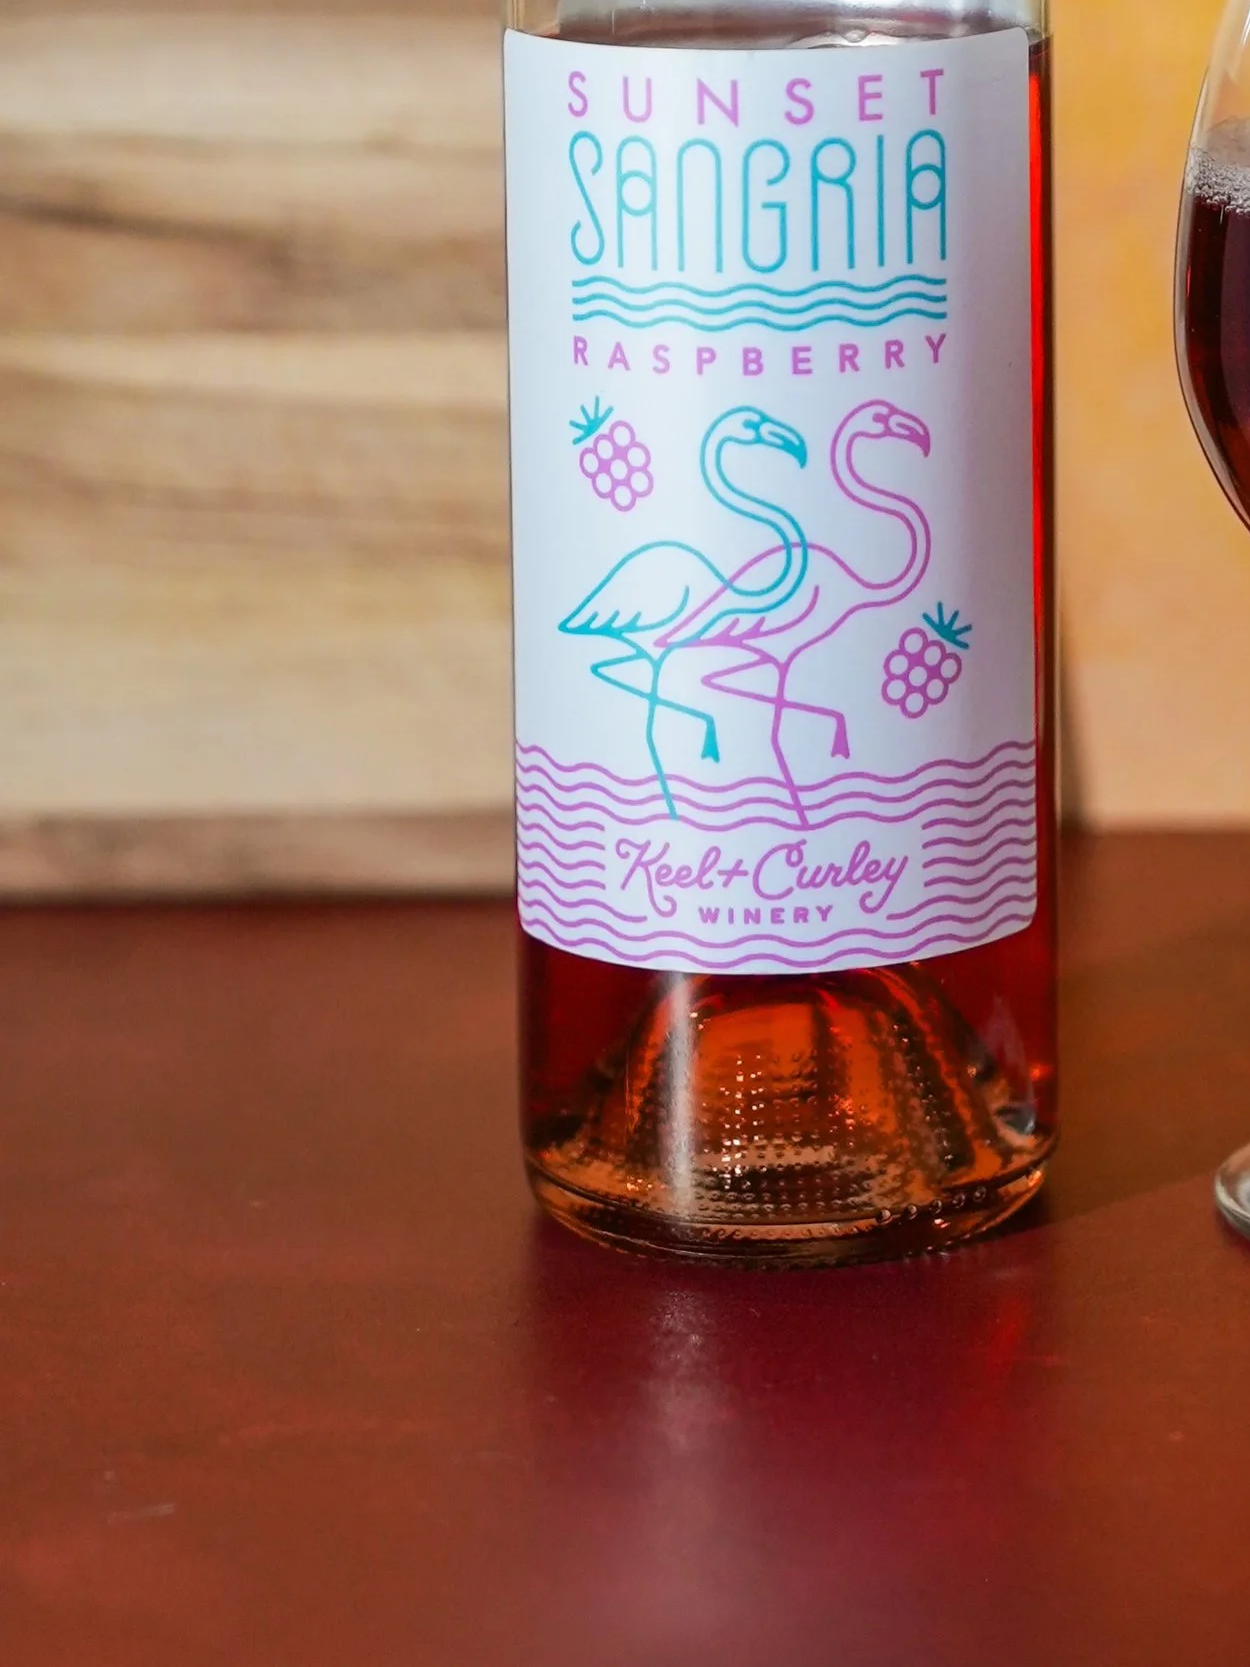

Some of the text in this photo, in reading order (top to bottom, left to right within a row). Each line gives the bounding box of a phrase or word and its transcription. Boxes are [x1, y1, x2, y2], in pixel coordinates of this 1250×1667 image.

[567, 67, 945, 128] SUNSET
[568, 129, 948, 274] SANGRIA
[572, 334, 948, 377] RASPBERRY
[752, 838, 909, 914] Curley
[698, 904, 835, 925] WINERY
